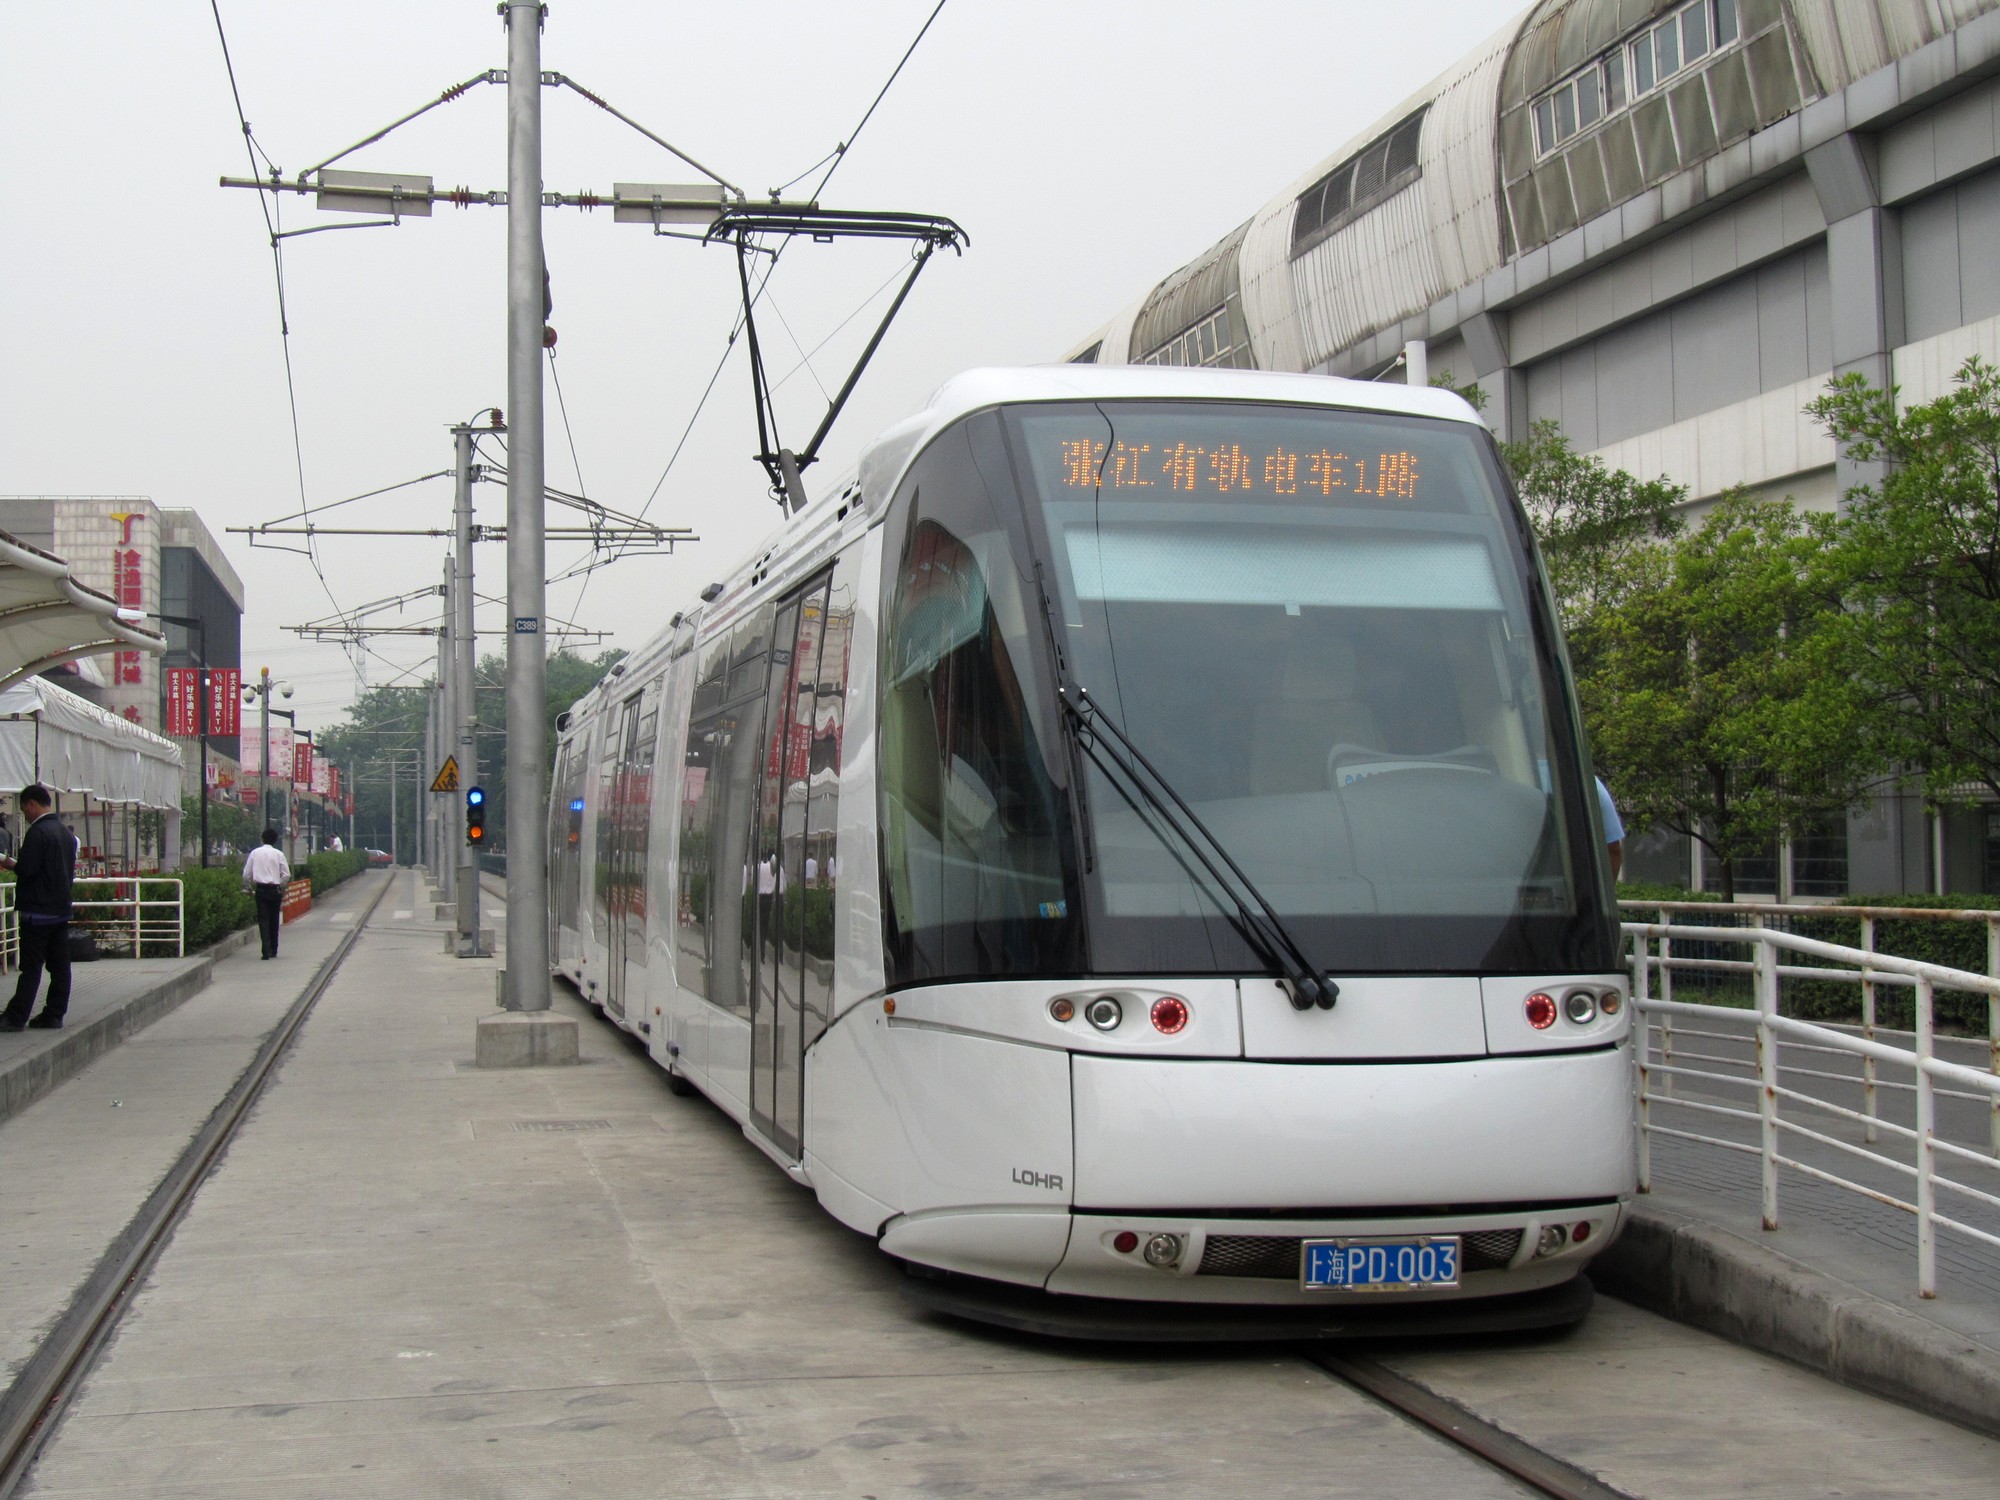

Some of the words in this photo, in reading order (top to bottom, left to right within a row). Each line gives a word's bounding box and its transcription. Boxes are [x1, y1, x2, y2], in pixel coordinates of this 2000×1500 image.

[516, 620, 537, 631] C389
[186, 685, 194, 733] 好乐迪KTV
[214, 685, 223, 734] 好乐迪KTV
[1012, 1167, 1064, 1191] LOHR
